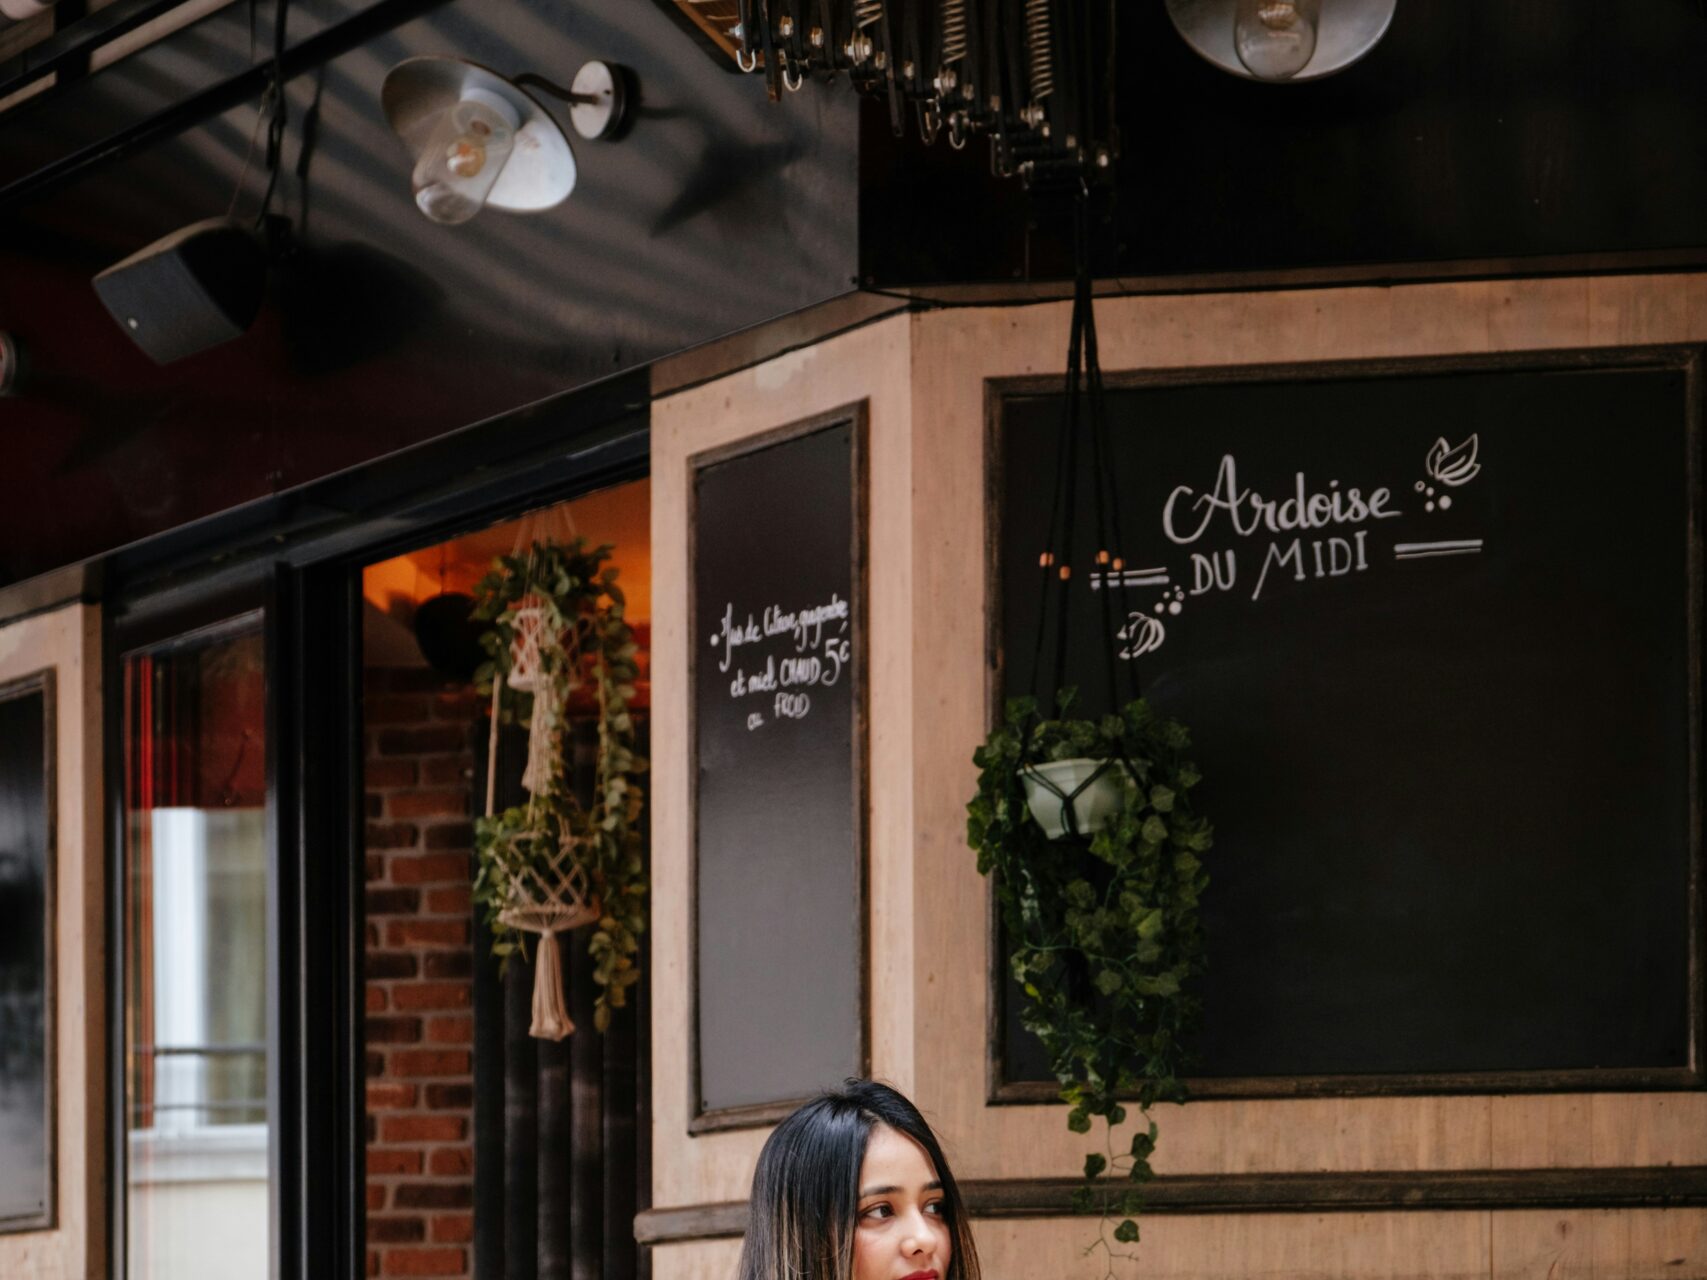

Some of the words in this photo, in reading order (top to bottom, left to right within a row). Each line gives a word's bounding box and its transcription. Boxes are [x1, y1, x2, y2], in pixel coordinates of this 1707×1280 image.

[1163, 454, 1402, 544] Ardoise
[1189, 549, 1236, 596] DU
[1252, 530, 1369, 601] MIDI
